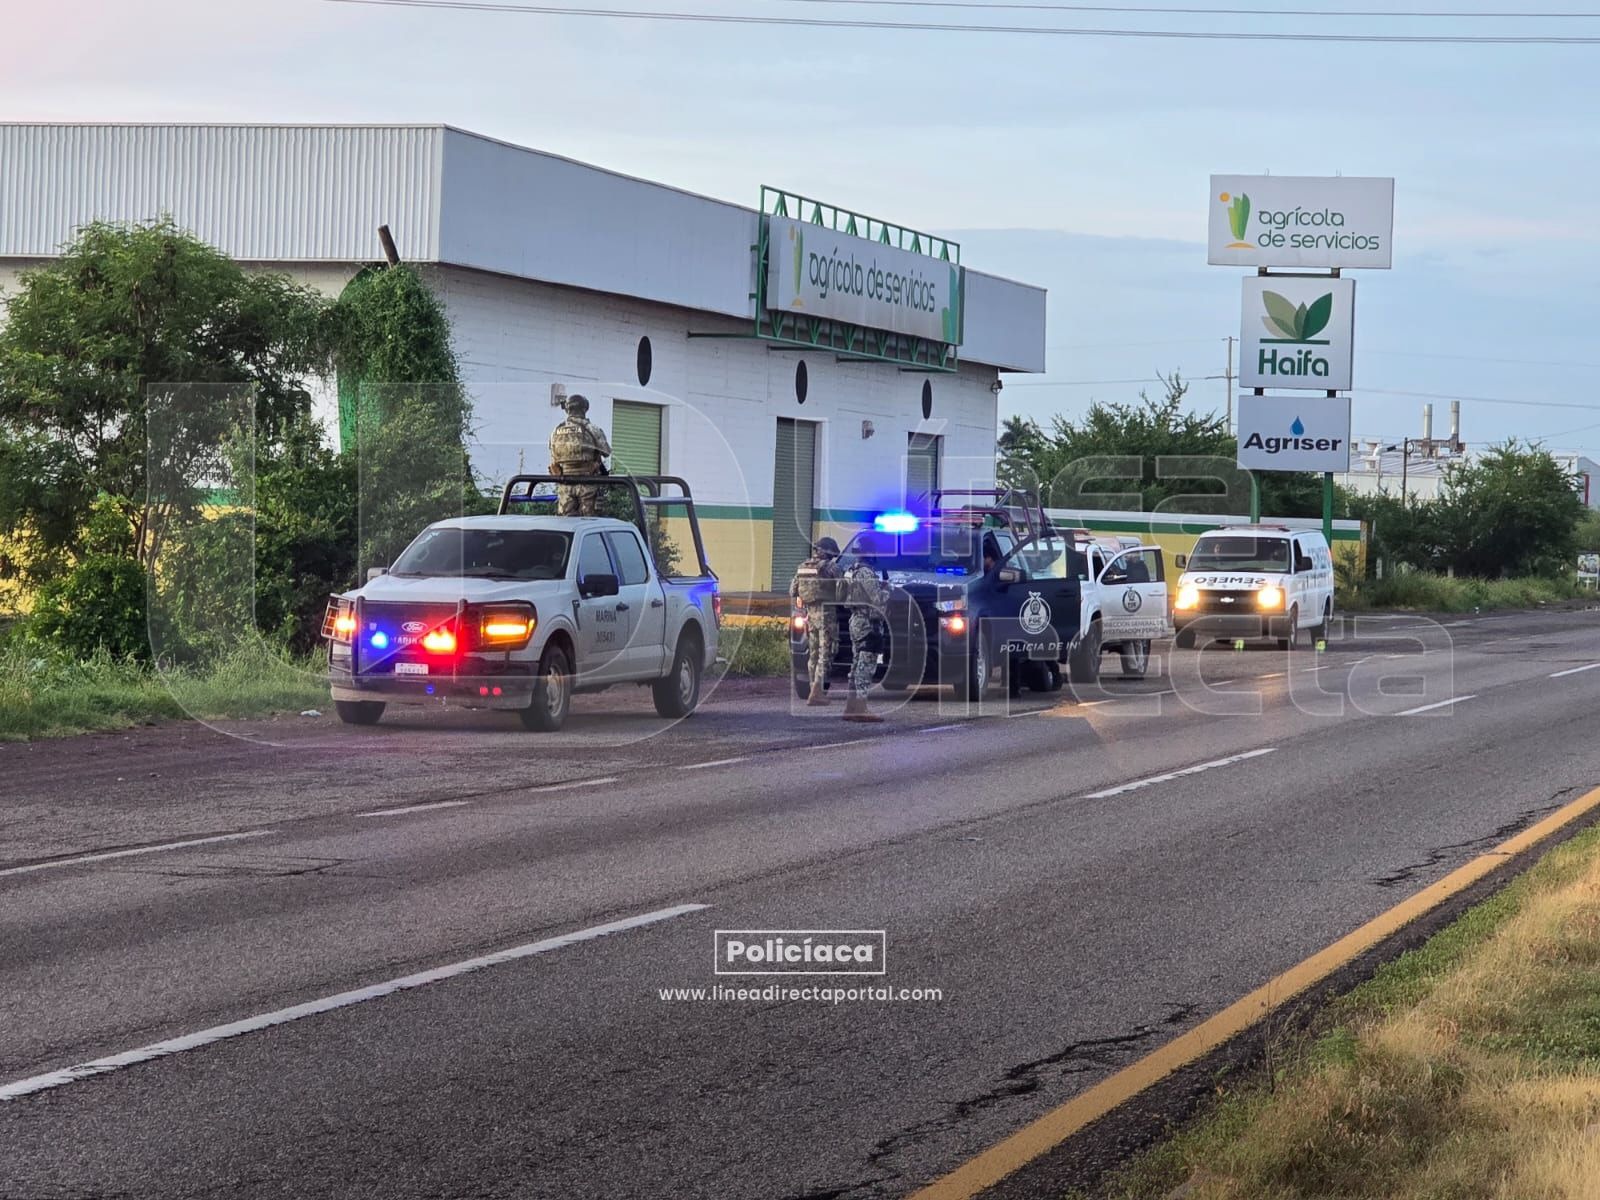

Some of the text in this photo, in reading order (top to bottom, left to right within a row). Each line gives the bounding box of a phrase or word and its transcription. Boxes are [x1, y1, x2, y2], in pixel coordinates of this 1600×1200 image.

[1258, 206, 1344, 230] agrícola
[1258, 230, 1380, 250] de servicios
[809, 245, 936, 312] agrícola de servicios
[1258, 349, 1330, 377] Haifa
[1243, 432, 1342, 454] Agriser
[1000, 642, 1045, 653] POLICIA
[1047, 642, 1064, 651] DE
